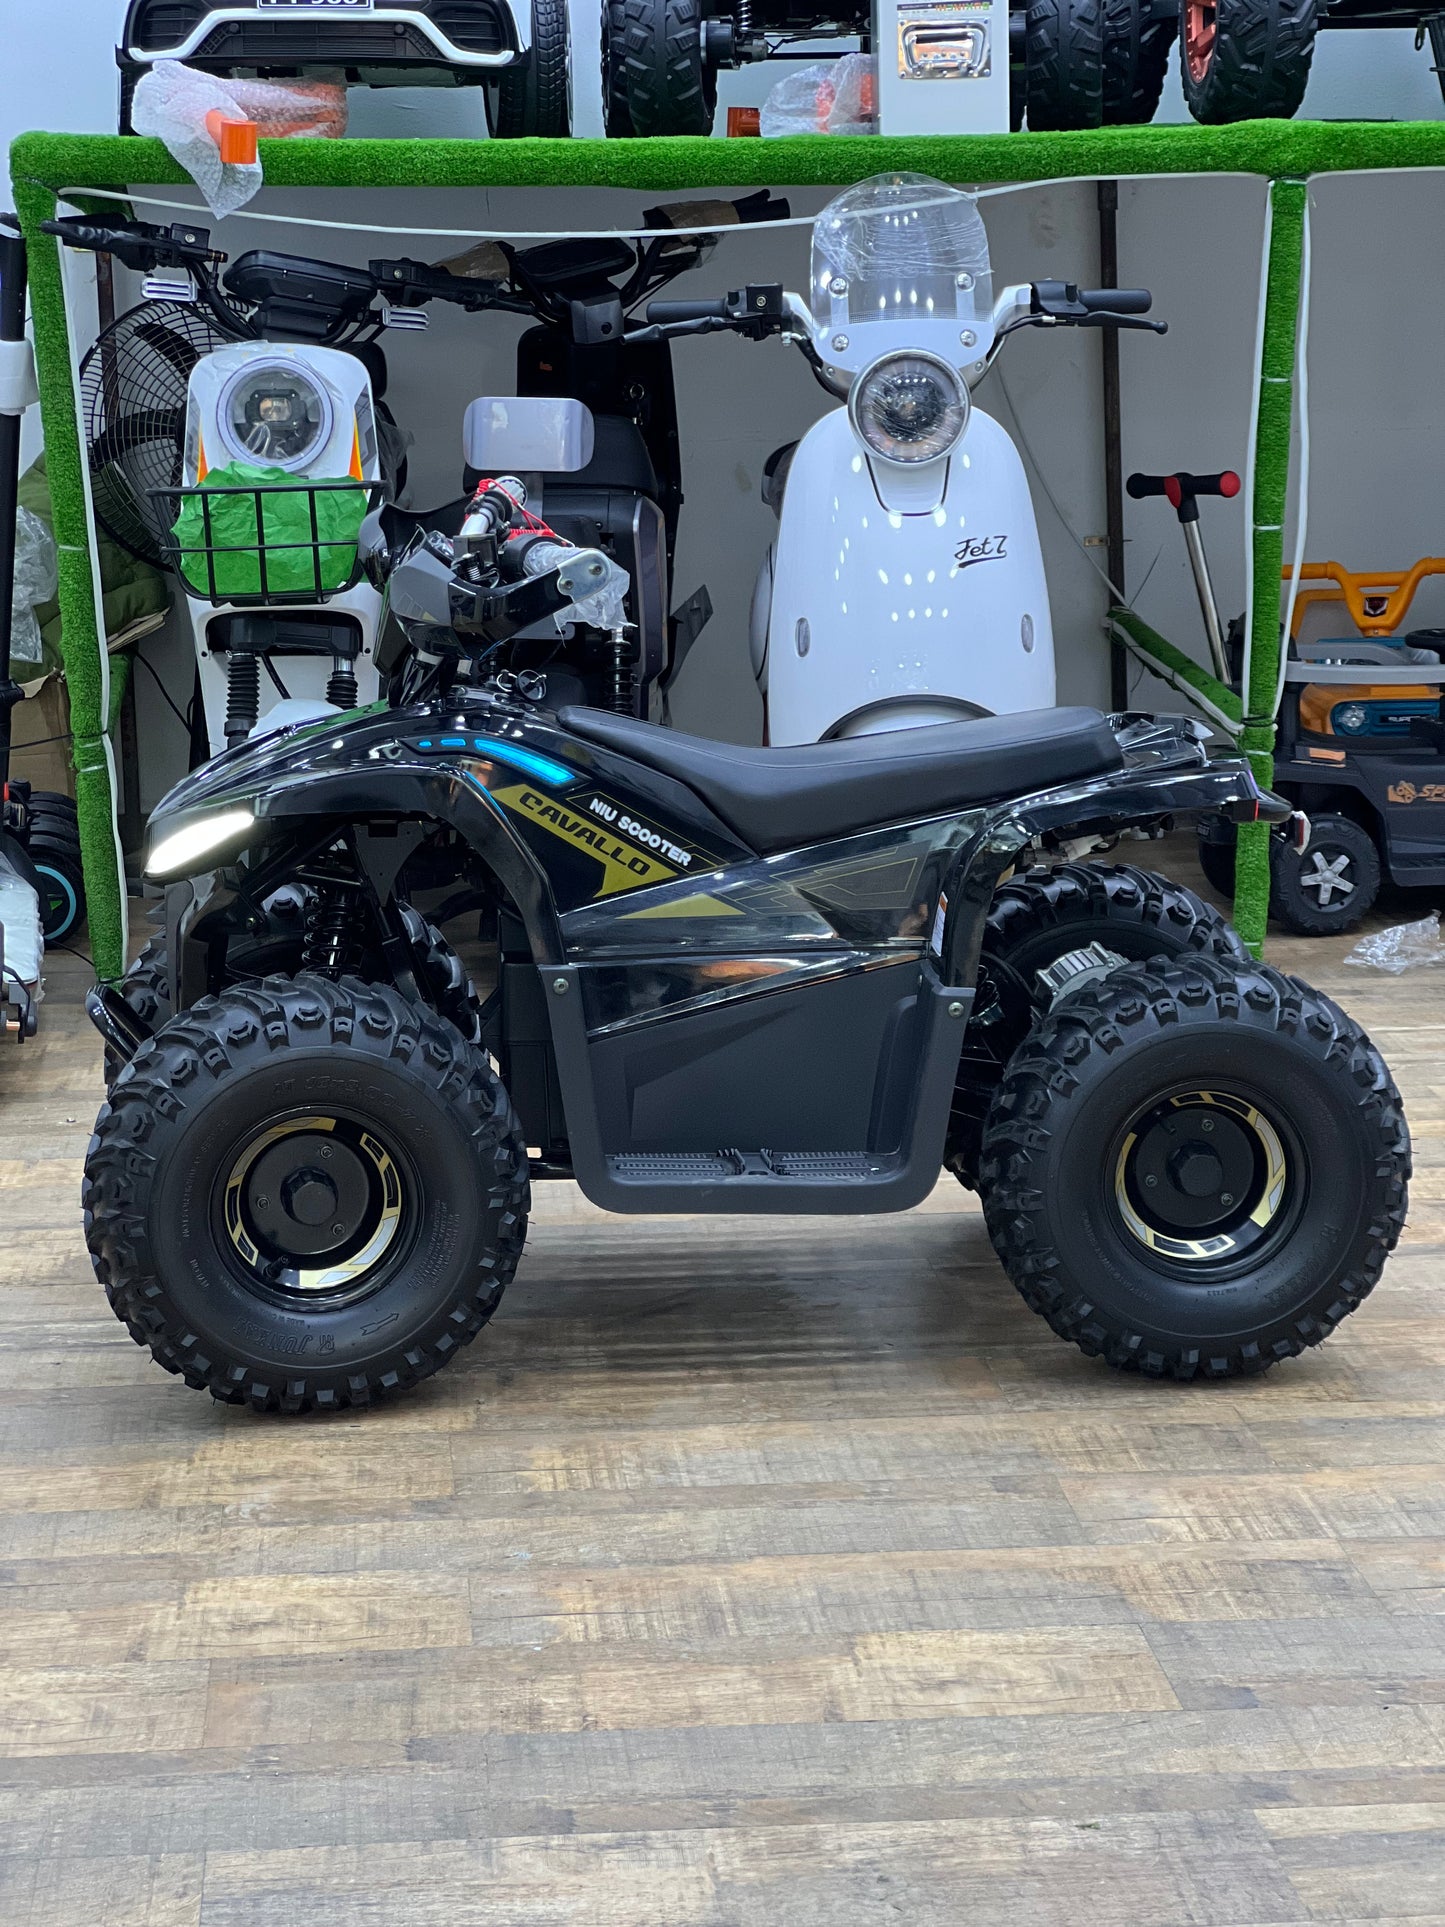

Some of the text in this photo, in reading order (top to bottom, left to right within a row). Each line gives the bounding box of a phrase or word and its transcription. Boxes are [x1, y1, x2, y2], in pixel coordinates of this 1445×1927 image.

[519, 791, 652, 876] CAVALLO
[589, 797, 692, 867] NIU SCOOTER
